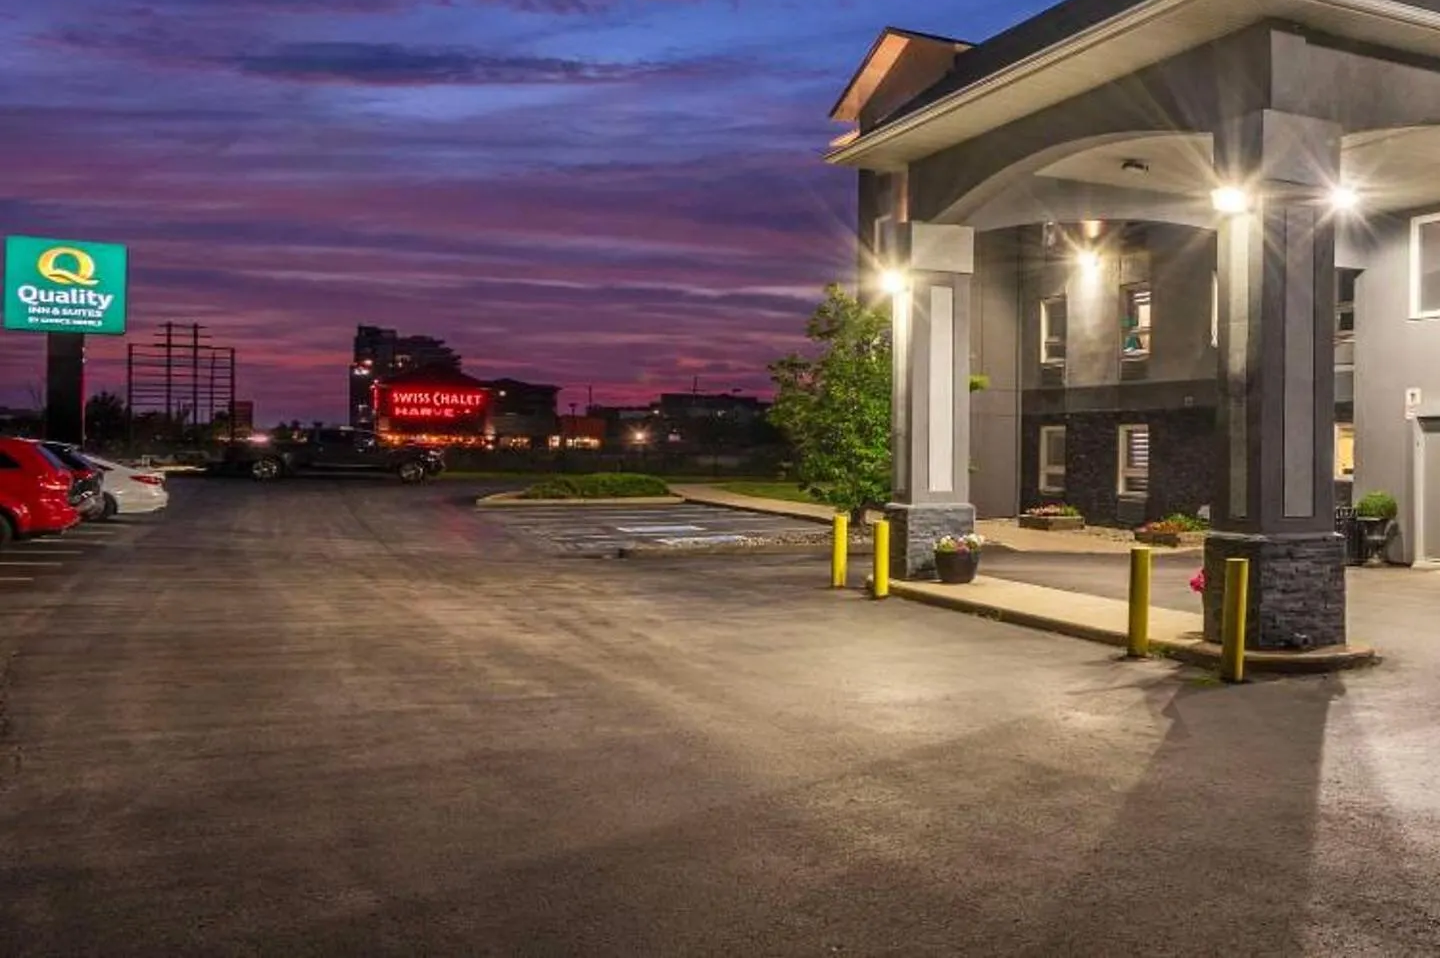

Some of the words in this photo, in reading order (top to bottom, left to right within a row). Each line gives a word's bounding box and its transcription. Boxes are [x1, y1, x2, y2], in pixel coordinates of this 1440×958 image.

[17, 284, 114, 310] Quality
[392, 392, 430, 403] SWISS
[433, 392, 482, 406] CHALET
